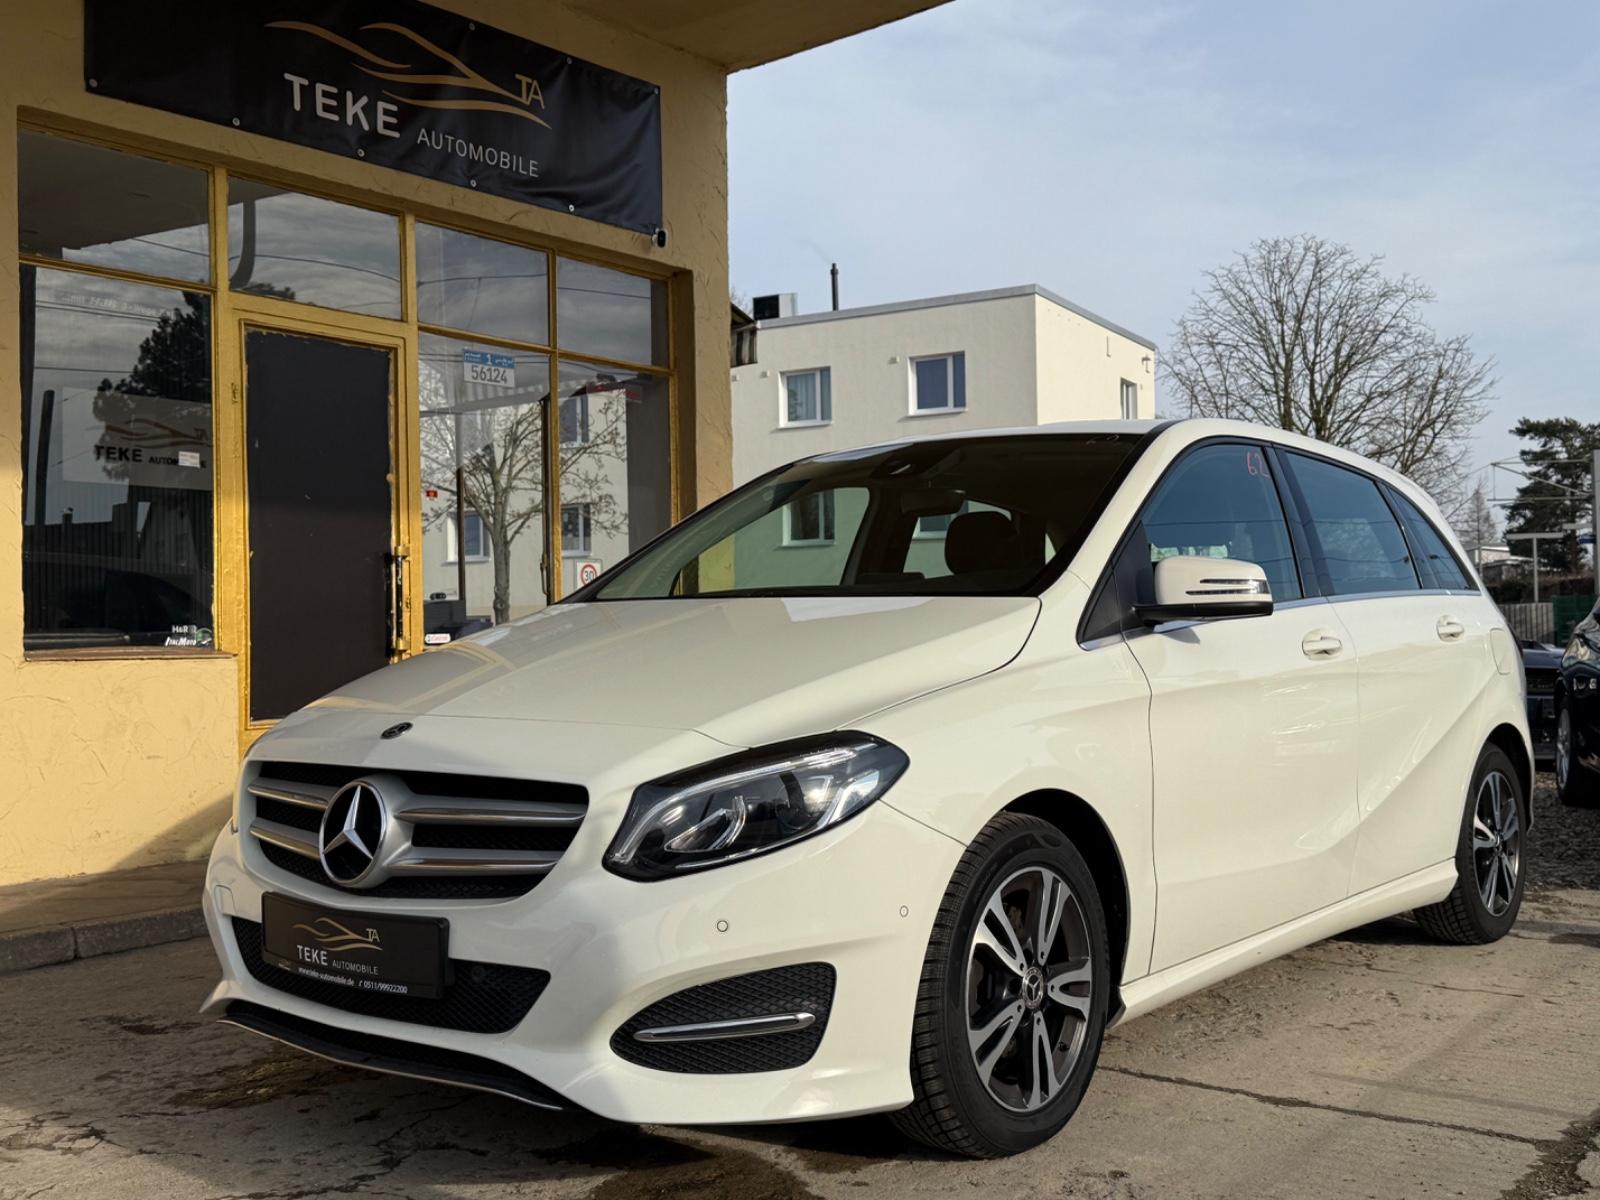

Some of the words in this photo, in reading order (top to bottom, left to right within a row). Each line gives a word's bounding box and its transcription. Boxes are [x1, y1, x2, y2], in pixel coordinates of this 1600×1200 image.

[515, 73, 545, 109] TA
[283, 72, 401, 138] TEKE
[416, 127, 540, 178] AUTOMOBILE
[471, 364, 508, 384] 56124
[94, 445, 143, 462] TEKE
[584, 570, 595, 582] 30
[296, 944, 328, 966] TEKE
[332, 959, 379, 976] AUTOMOBILE
